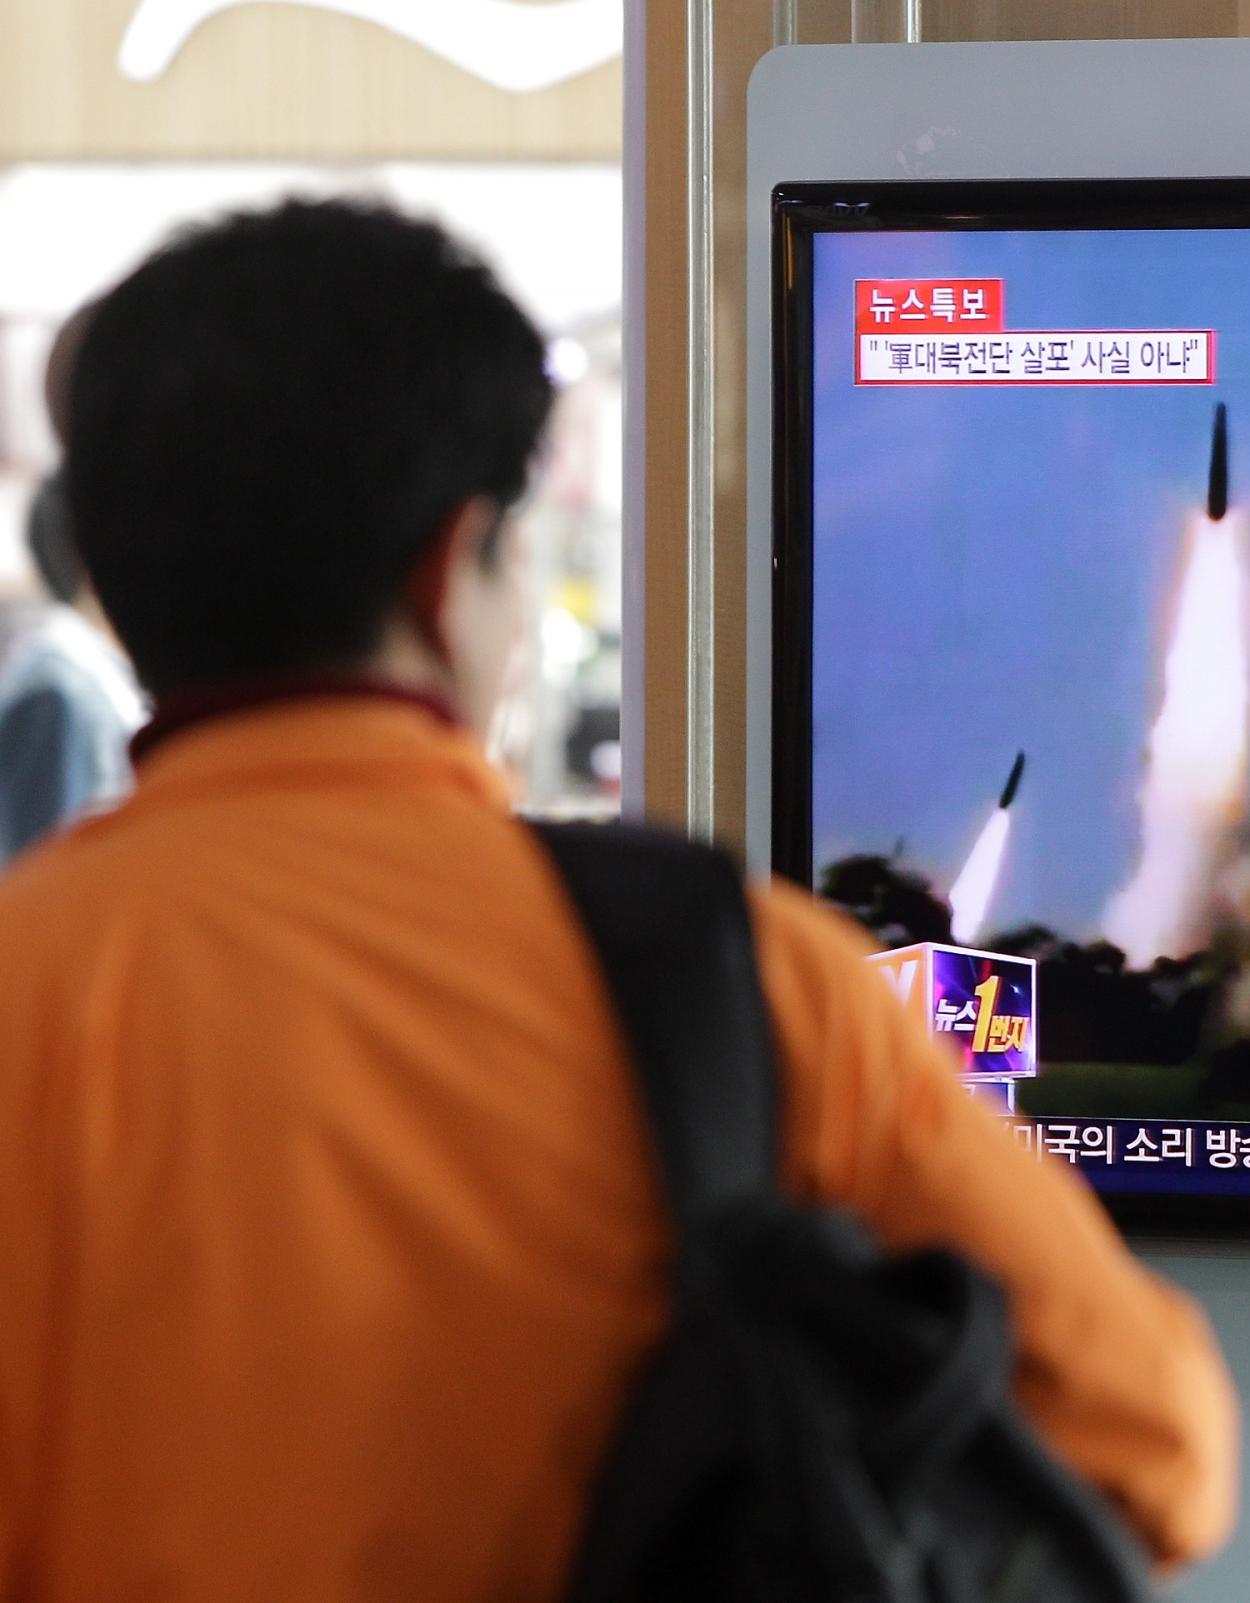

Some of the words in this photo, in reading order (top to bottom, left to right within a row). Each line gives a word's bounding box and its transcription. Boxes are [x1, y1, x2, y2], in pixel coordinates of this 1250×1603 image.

[869, 288, 987, 322] 뉴스특보
[1020, 340, 1074, 373] 살포'
[1081, 341, 1130, 373] 사실
[1140, 339, 1198, 373] 아냐"
[1124, 1127, 1192, 1167] 소리
